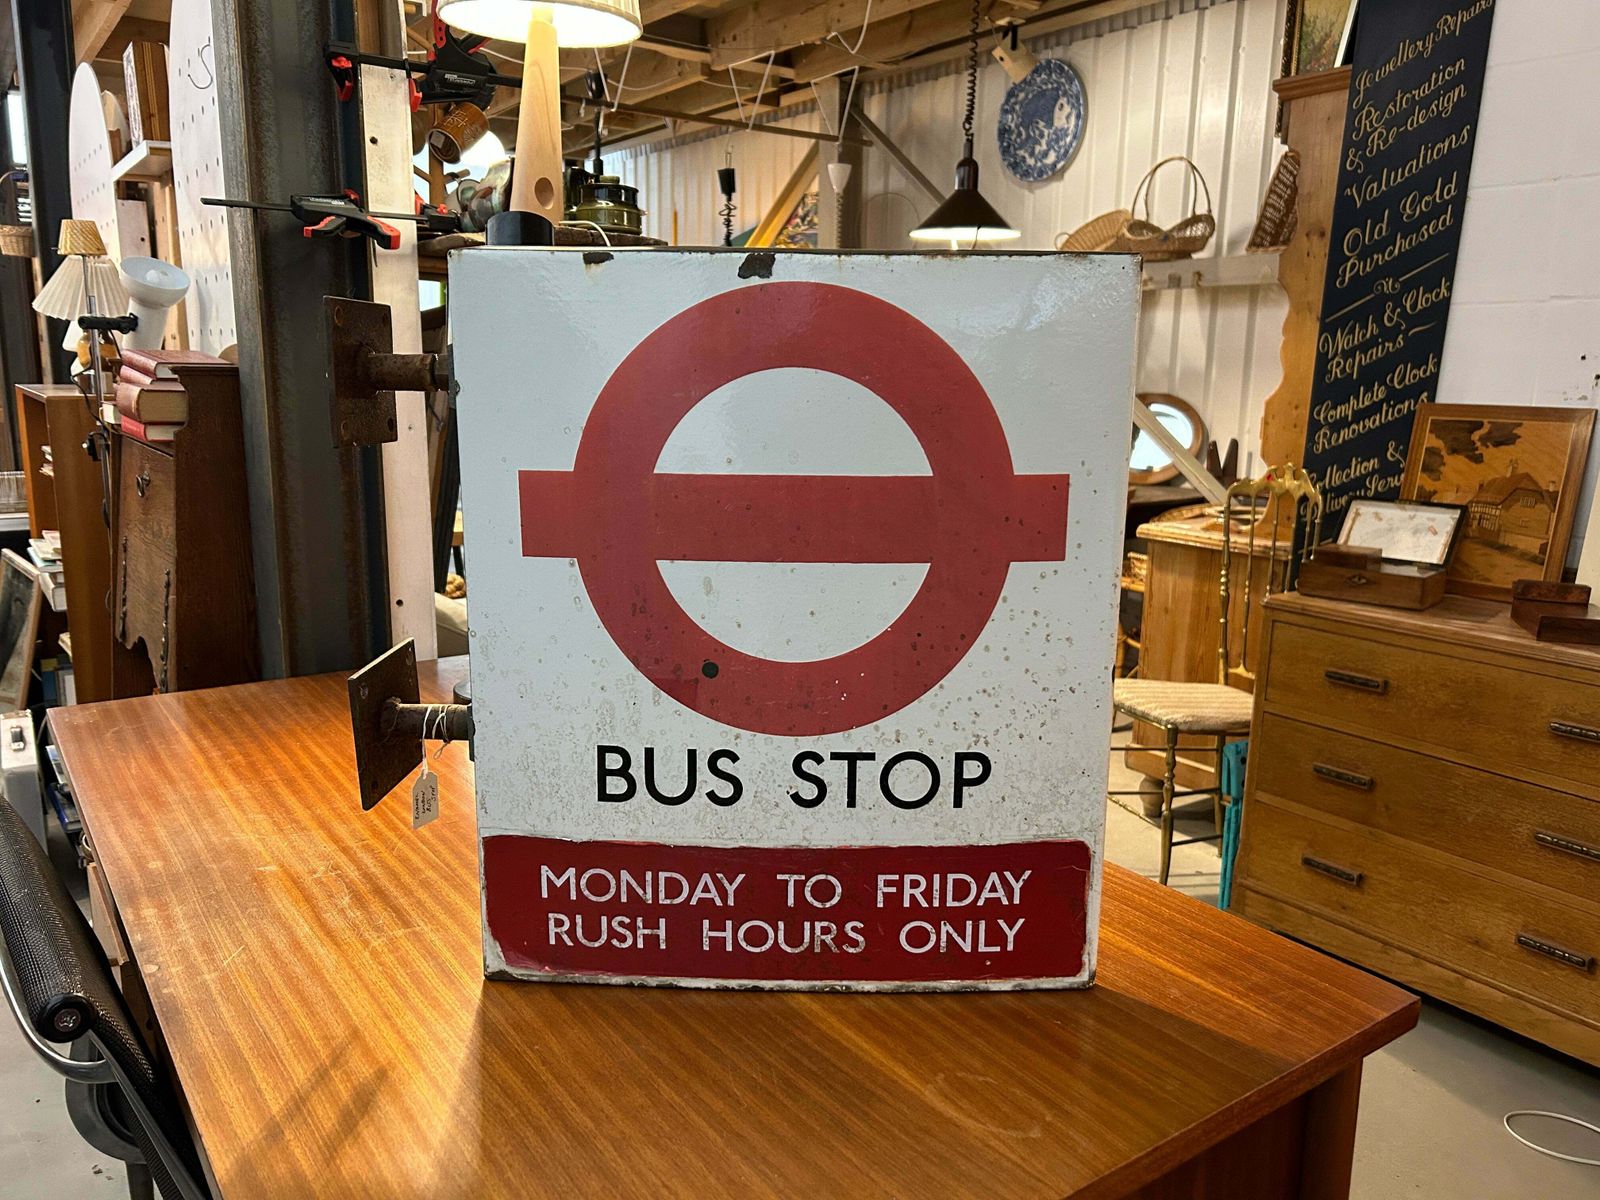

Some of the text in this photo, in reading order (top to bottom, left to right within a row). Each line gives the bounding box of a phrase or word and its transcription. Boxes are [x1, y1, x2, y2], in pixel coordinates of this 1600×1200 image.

[1353, 33, 1434, 109] Jewellery
[1353, 58, 1466, 141] Restoration
[1346, 83, 1467, 173] & Re-design
[1344, 124, 1471, 209] Valuations
[1336, 205, 1453, 288] Purchased
[1343, 171, 1458, 257] Old Gold
[1319, 277, 1450, 359] Watch & Clock
[1314, 354, 1437, 424] Complete Clock
[1325, 334, 1404, 384] Repairs
[1387, 441, 1405, 468] &
[597, 745, 991, 809] BUS STOP
[541, 865, 1032, 908] MONDAY TO FRIDAY
[548, 913, 1025, 954] RUSH HOURS ONLY
